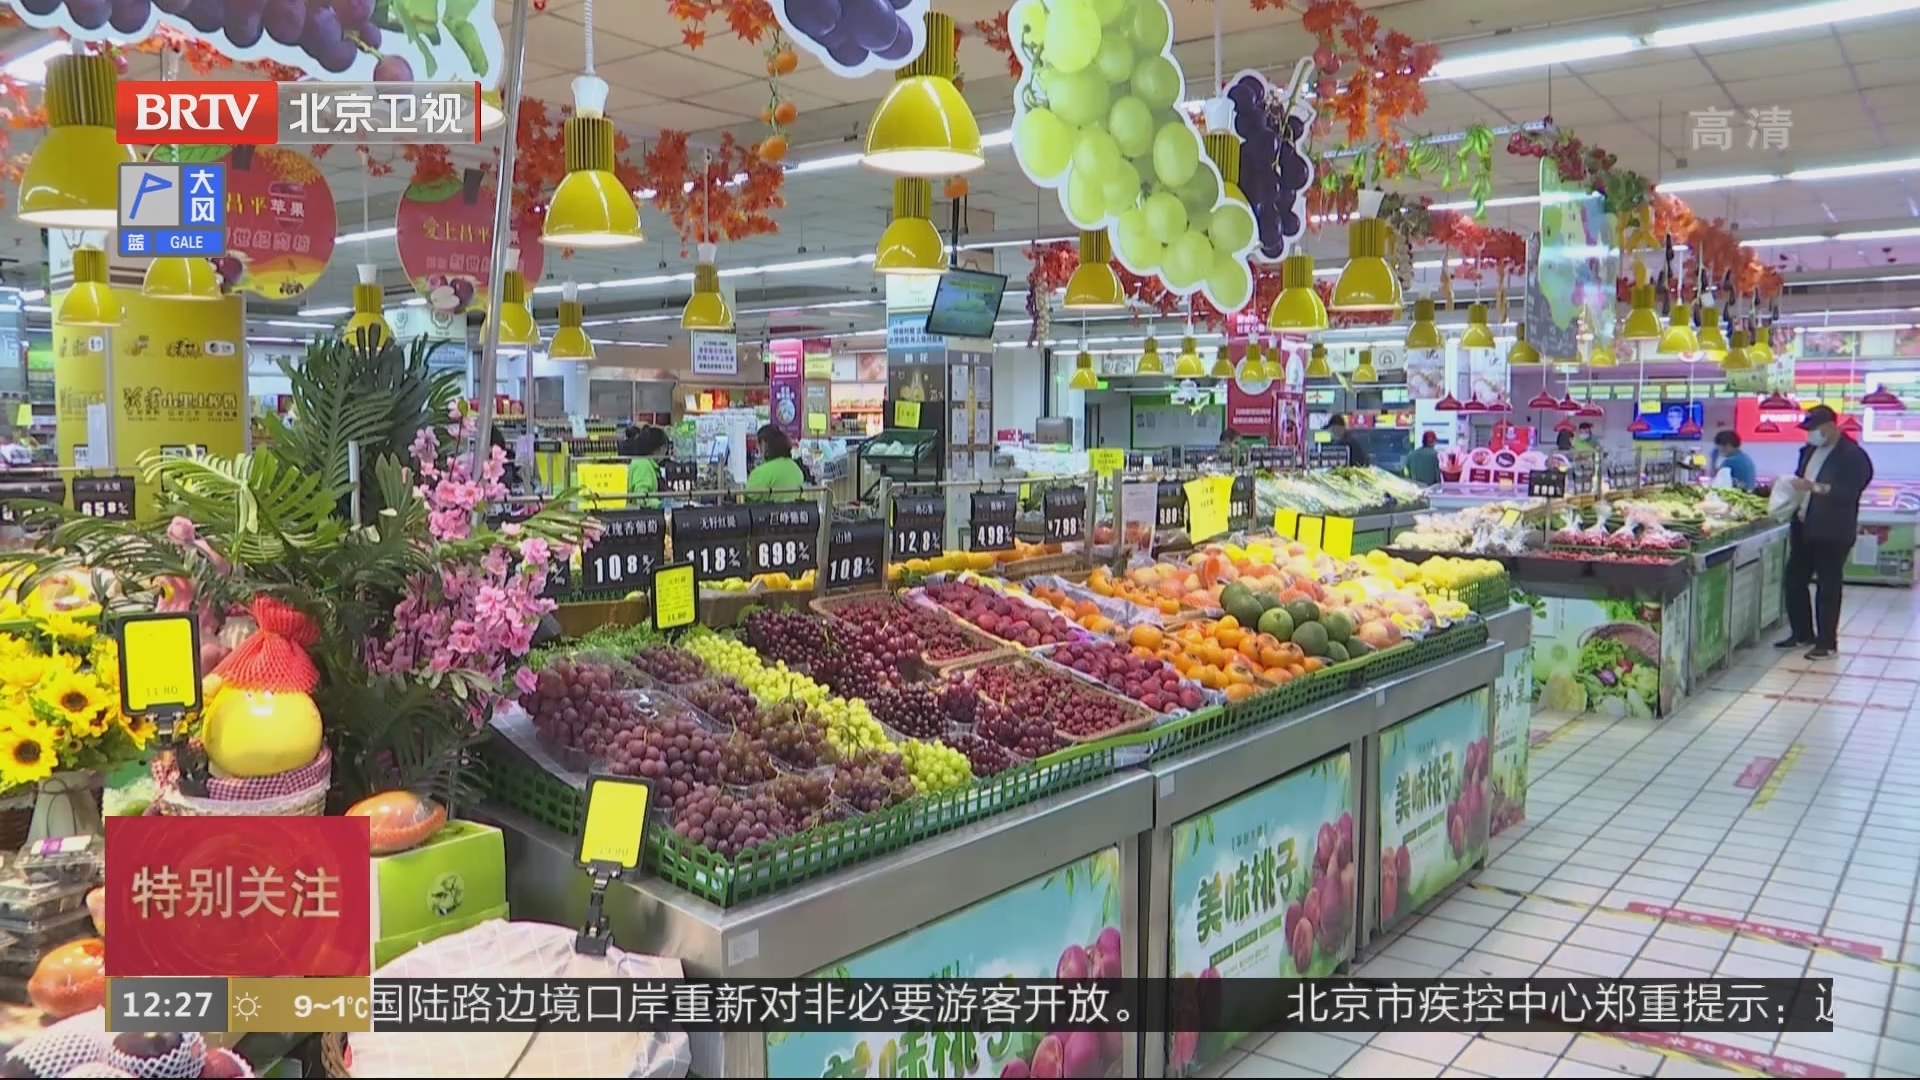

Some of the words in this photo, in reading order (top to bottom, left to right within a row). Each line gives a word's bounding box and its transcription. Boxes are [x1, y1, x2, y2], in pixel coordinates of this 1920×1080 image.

[594, 553, 638, 583] 10.8
[1395, 751, 1455, 825] 美味桃子
[1196, 837, 1298, 944] 美味桃子
